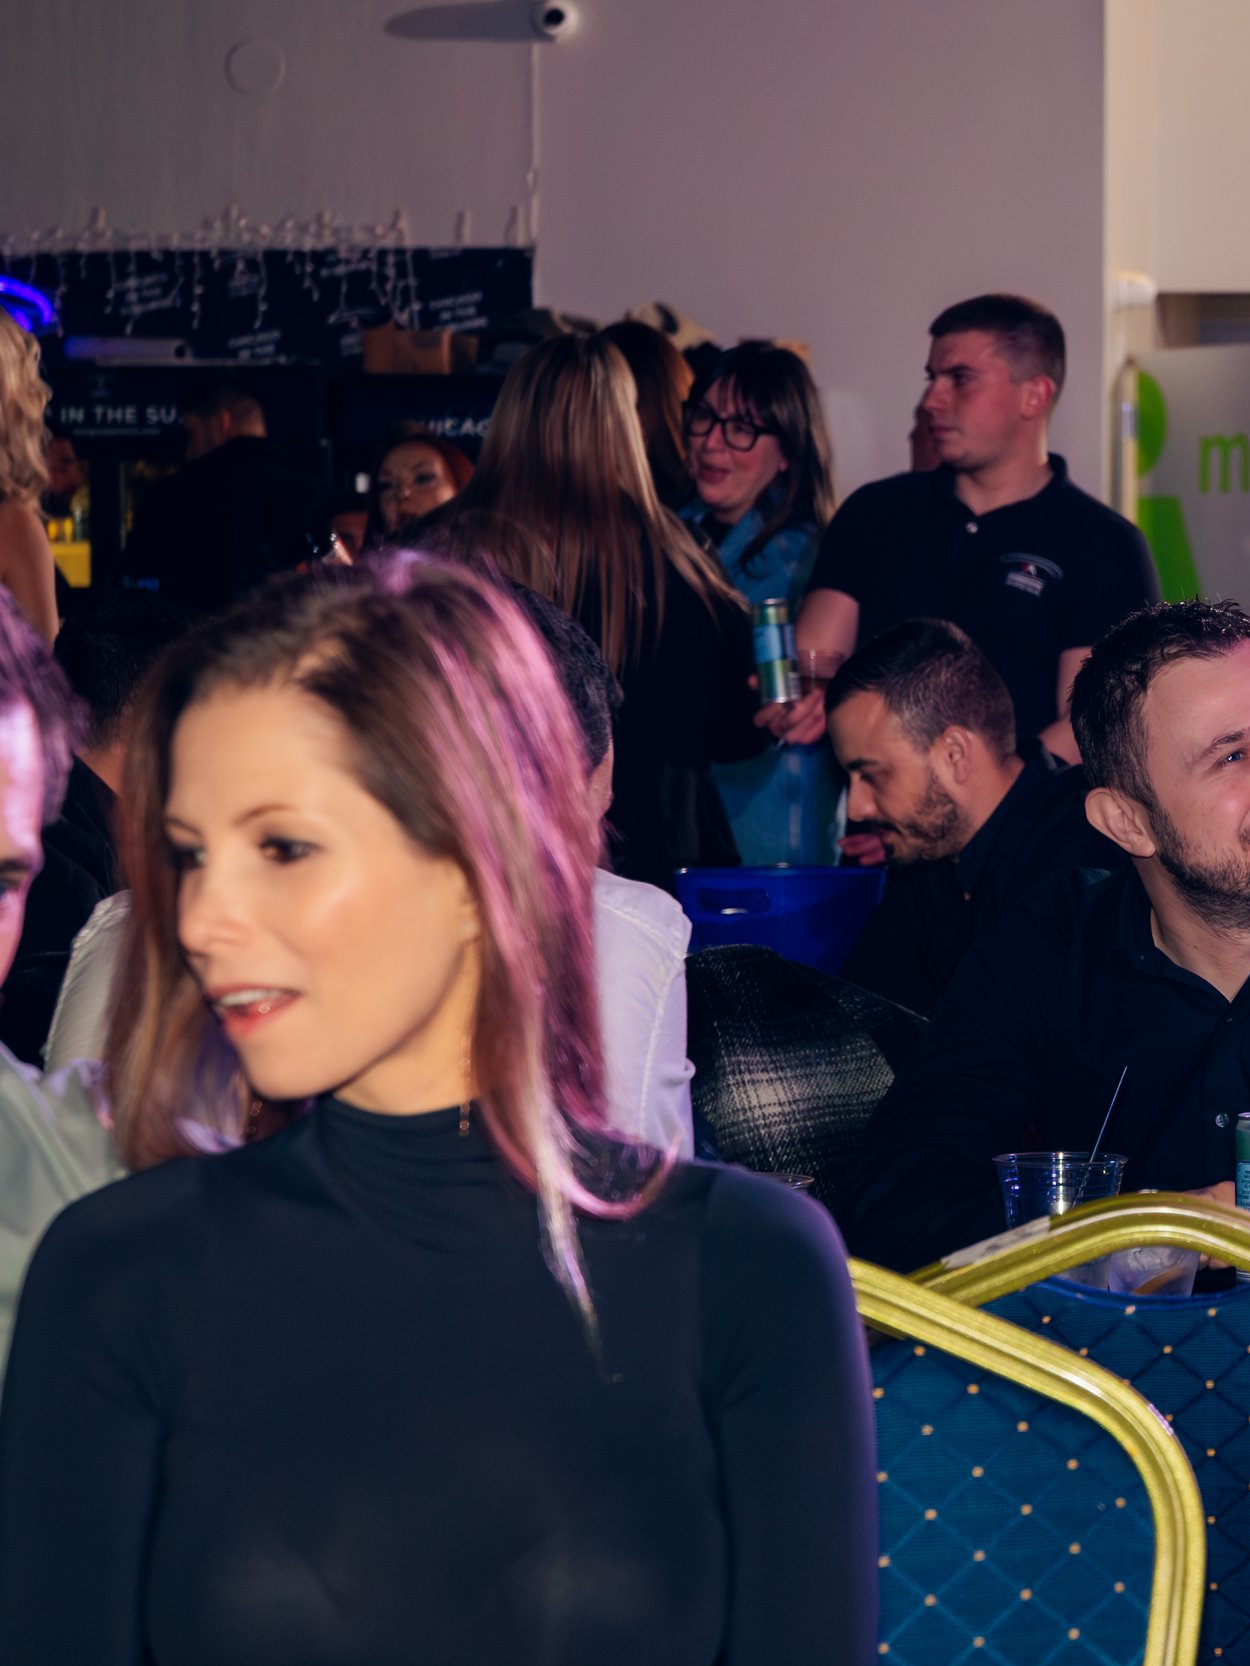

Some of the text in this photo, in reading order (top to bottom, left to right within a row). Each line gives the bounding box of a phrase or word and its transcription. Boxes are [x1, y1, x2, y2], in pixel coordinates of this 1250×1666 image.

[60, 404, 184, 424] IN THE SU
